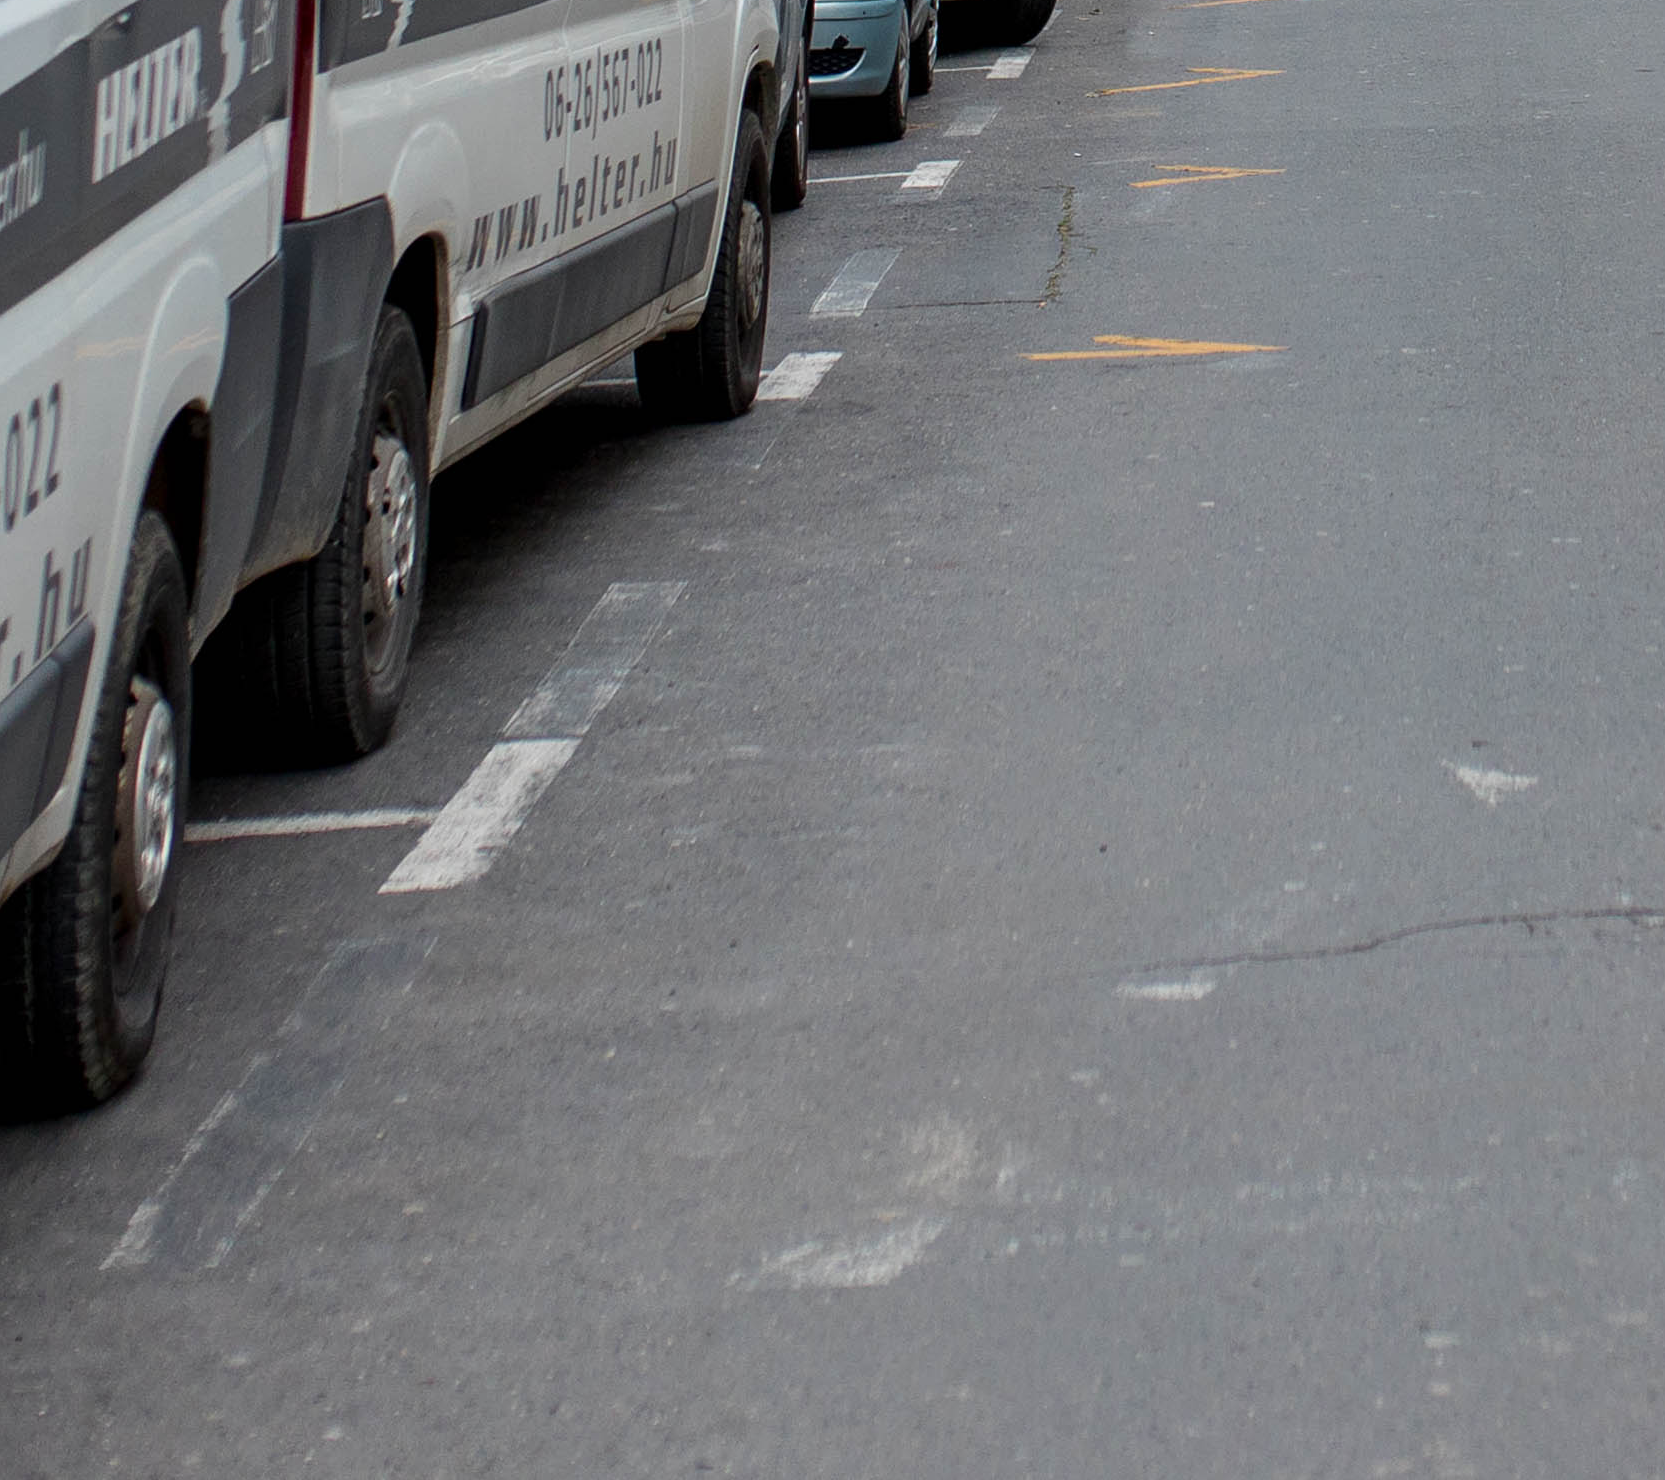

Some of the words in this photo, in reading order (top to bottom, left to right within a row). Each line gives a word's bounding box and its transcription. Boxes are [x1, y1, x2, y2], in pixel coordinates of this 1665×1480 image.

[92, 27, 203, 184] HELTER
[544, 38, 663, 142] 06-26/567-022
[466, 130, 677, 273] www.helter.hu
